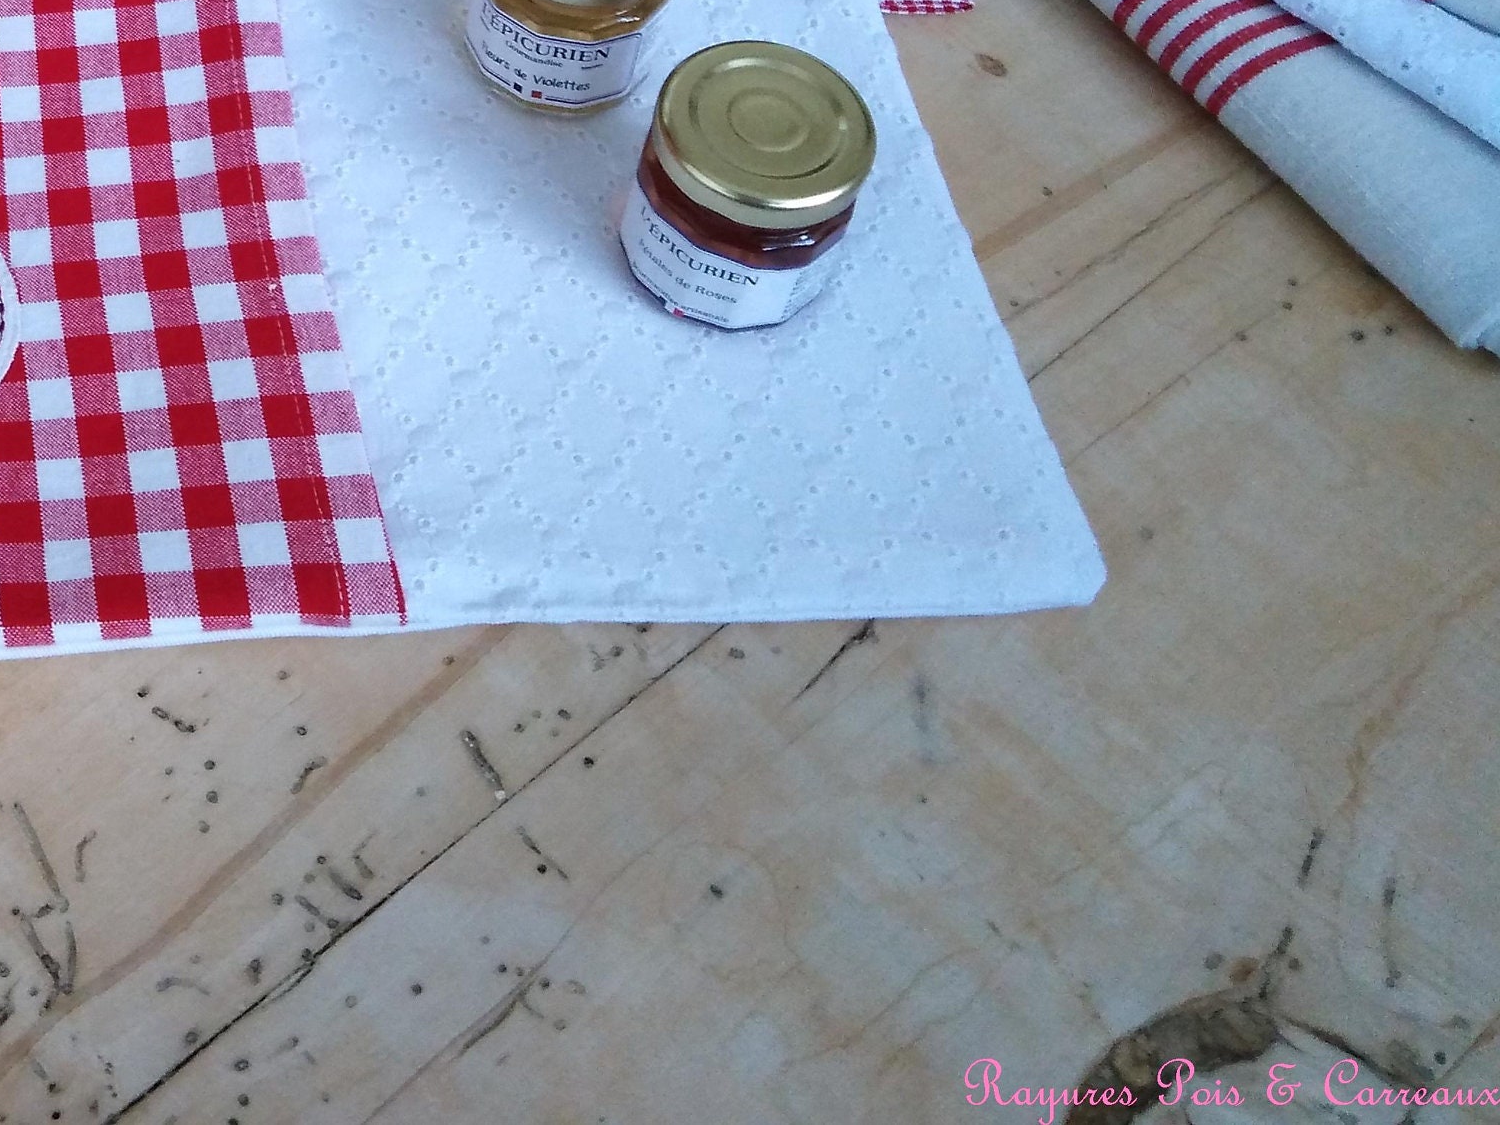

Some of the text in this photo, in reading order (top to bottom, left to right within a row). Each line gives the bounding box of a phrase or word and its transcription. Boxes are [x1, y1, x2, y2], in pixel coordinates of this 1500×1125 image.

[513, 66, 528, 81] de
[533, 74, 591, 92] Violettes
[675, 276, 692, 290] de
[695, 285, 738, 305] Roses
